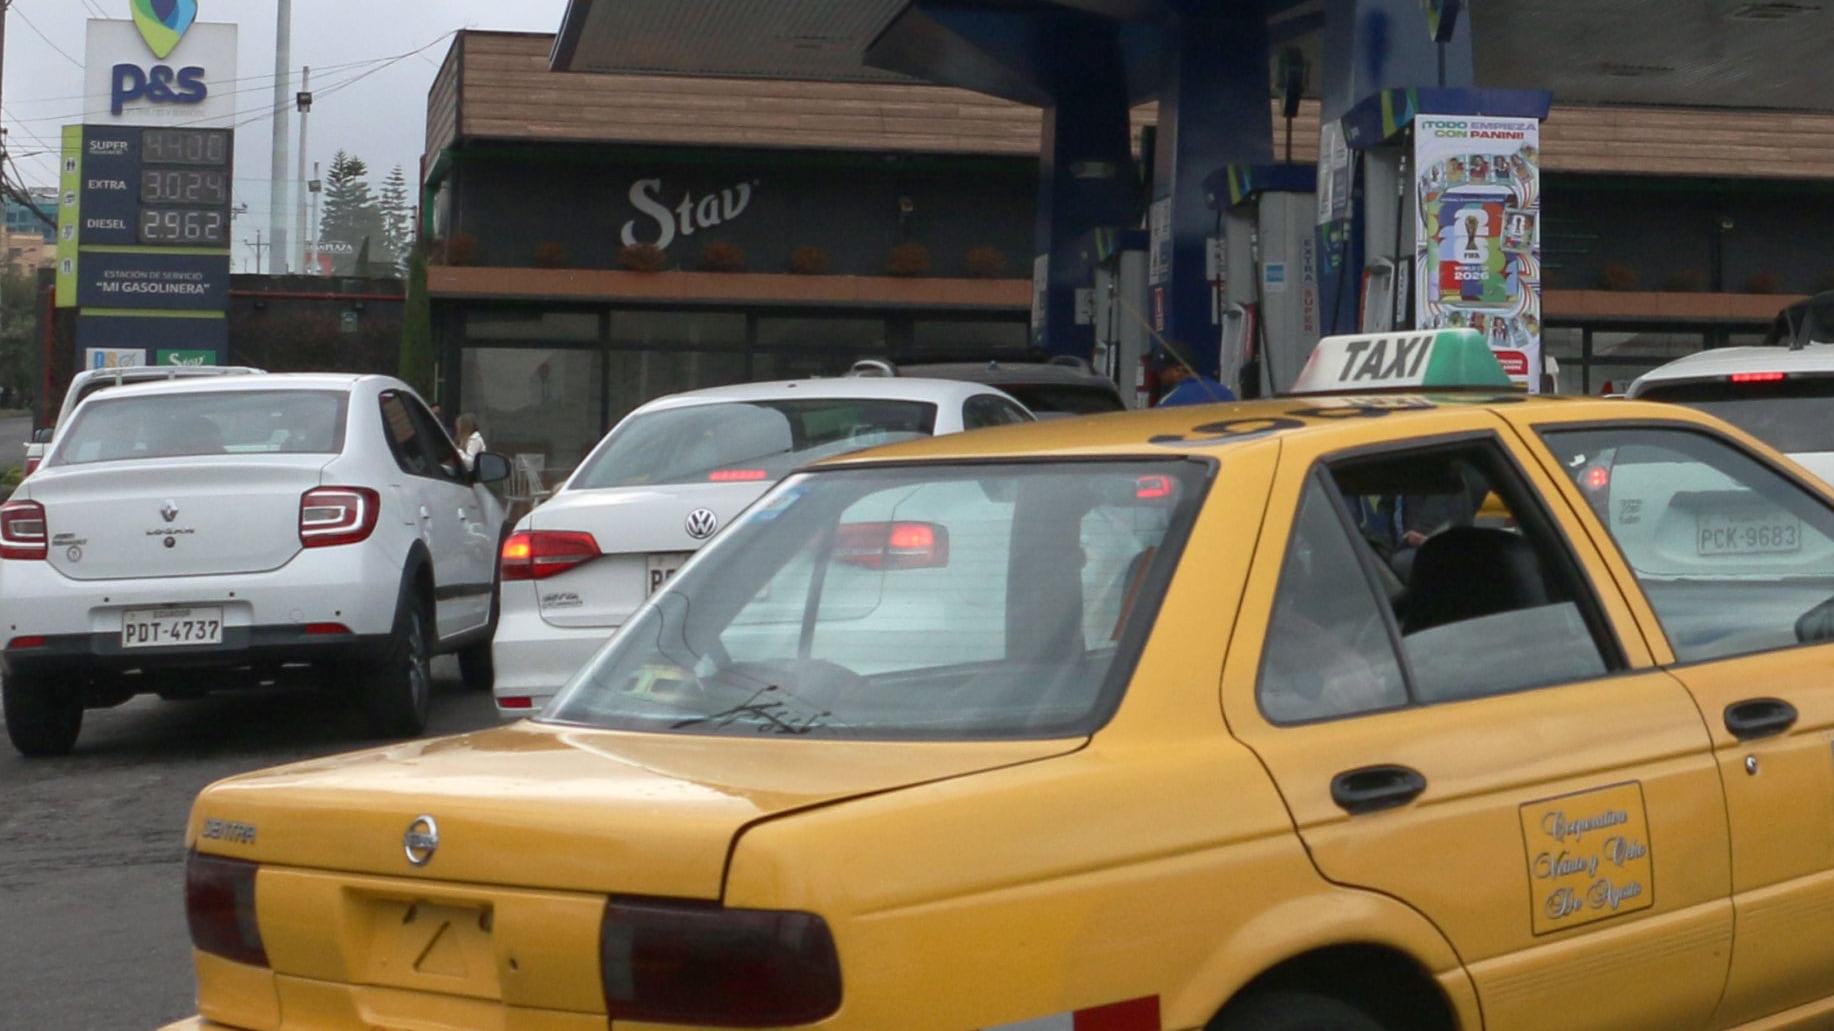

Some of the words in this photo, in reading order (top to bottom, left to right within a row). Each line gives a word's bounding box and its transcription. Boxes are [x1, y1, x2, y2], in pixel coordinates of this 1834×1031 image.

[1471, 122, 1536, 131] EMPIEZA
[1435, 130, 1467, 138] CON
[89, 140, 128, 150] SUPER
[88, 179, 127, 190] EXTRA
[621, 178, 750, 250] Stav
[87, 219, 126, 229] DIESEL
[1454, 271, 1489, 280] 2026
[1338, 336, 1433, 382] TAXI
[1701, 527, 1796, 550] PCK-9683
[126, 620, 219, 643] PDT-4737
